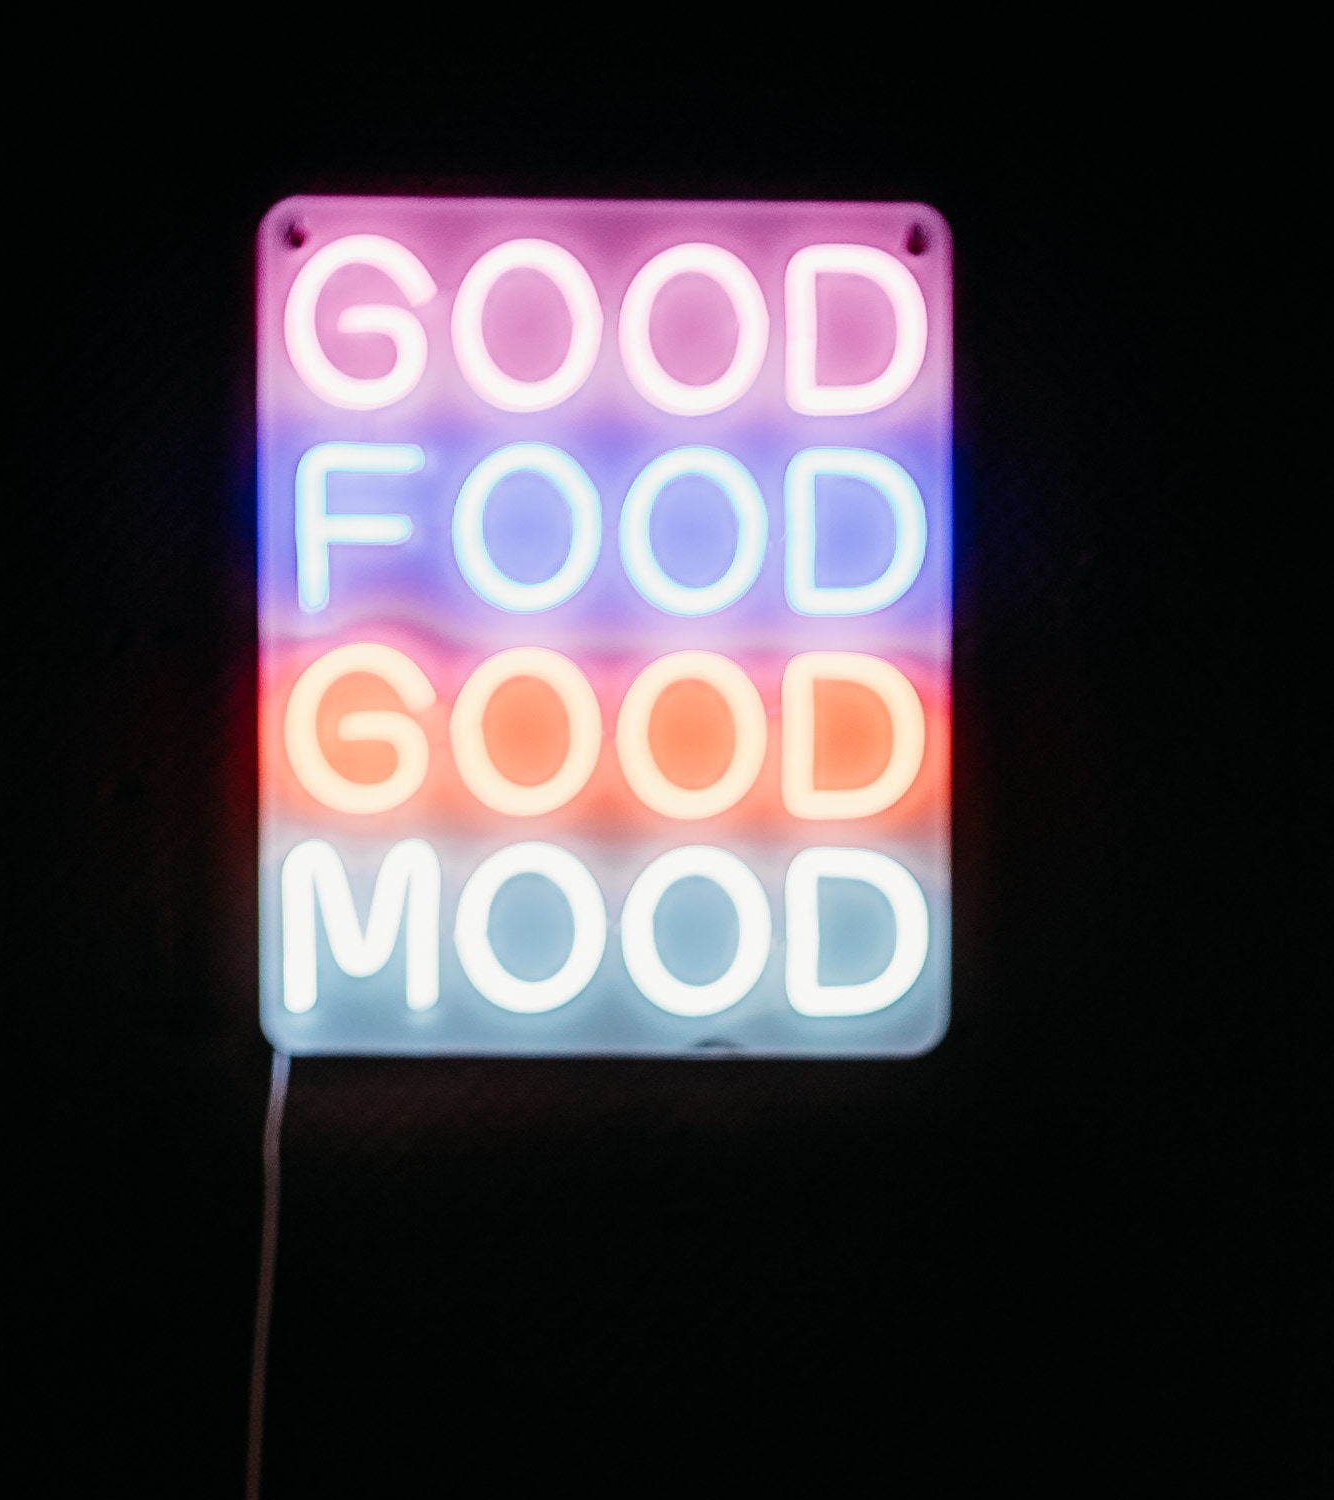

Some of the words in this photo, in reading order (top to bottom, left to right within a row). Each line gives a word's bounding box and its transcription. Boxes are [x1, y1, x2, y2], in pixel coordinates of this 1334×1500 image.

[283, 233, 929, 417] GOOD
[295, 440, 928, 617] FOOD
[283, 641, 926, 821] GOOD
[281, 838, 930, 1018] MOOD
